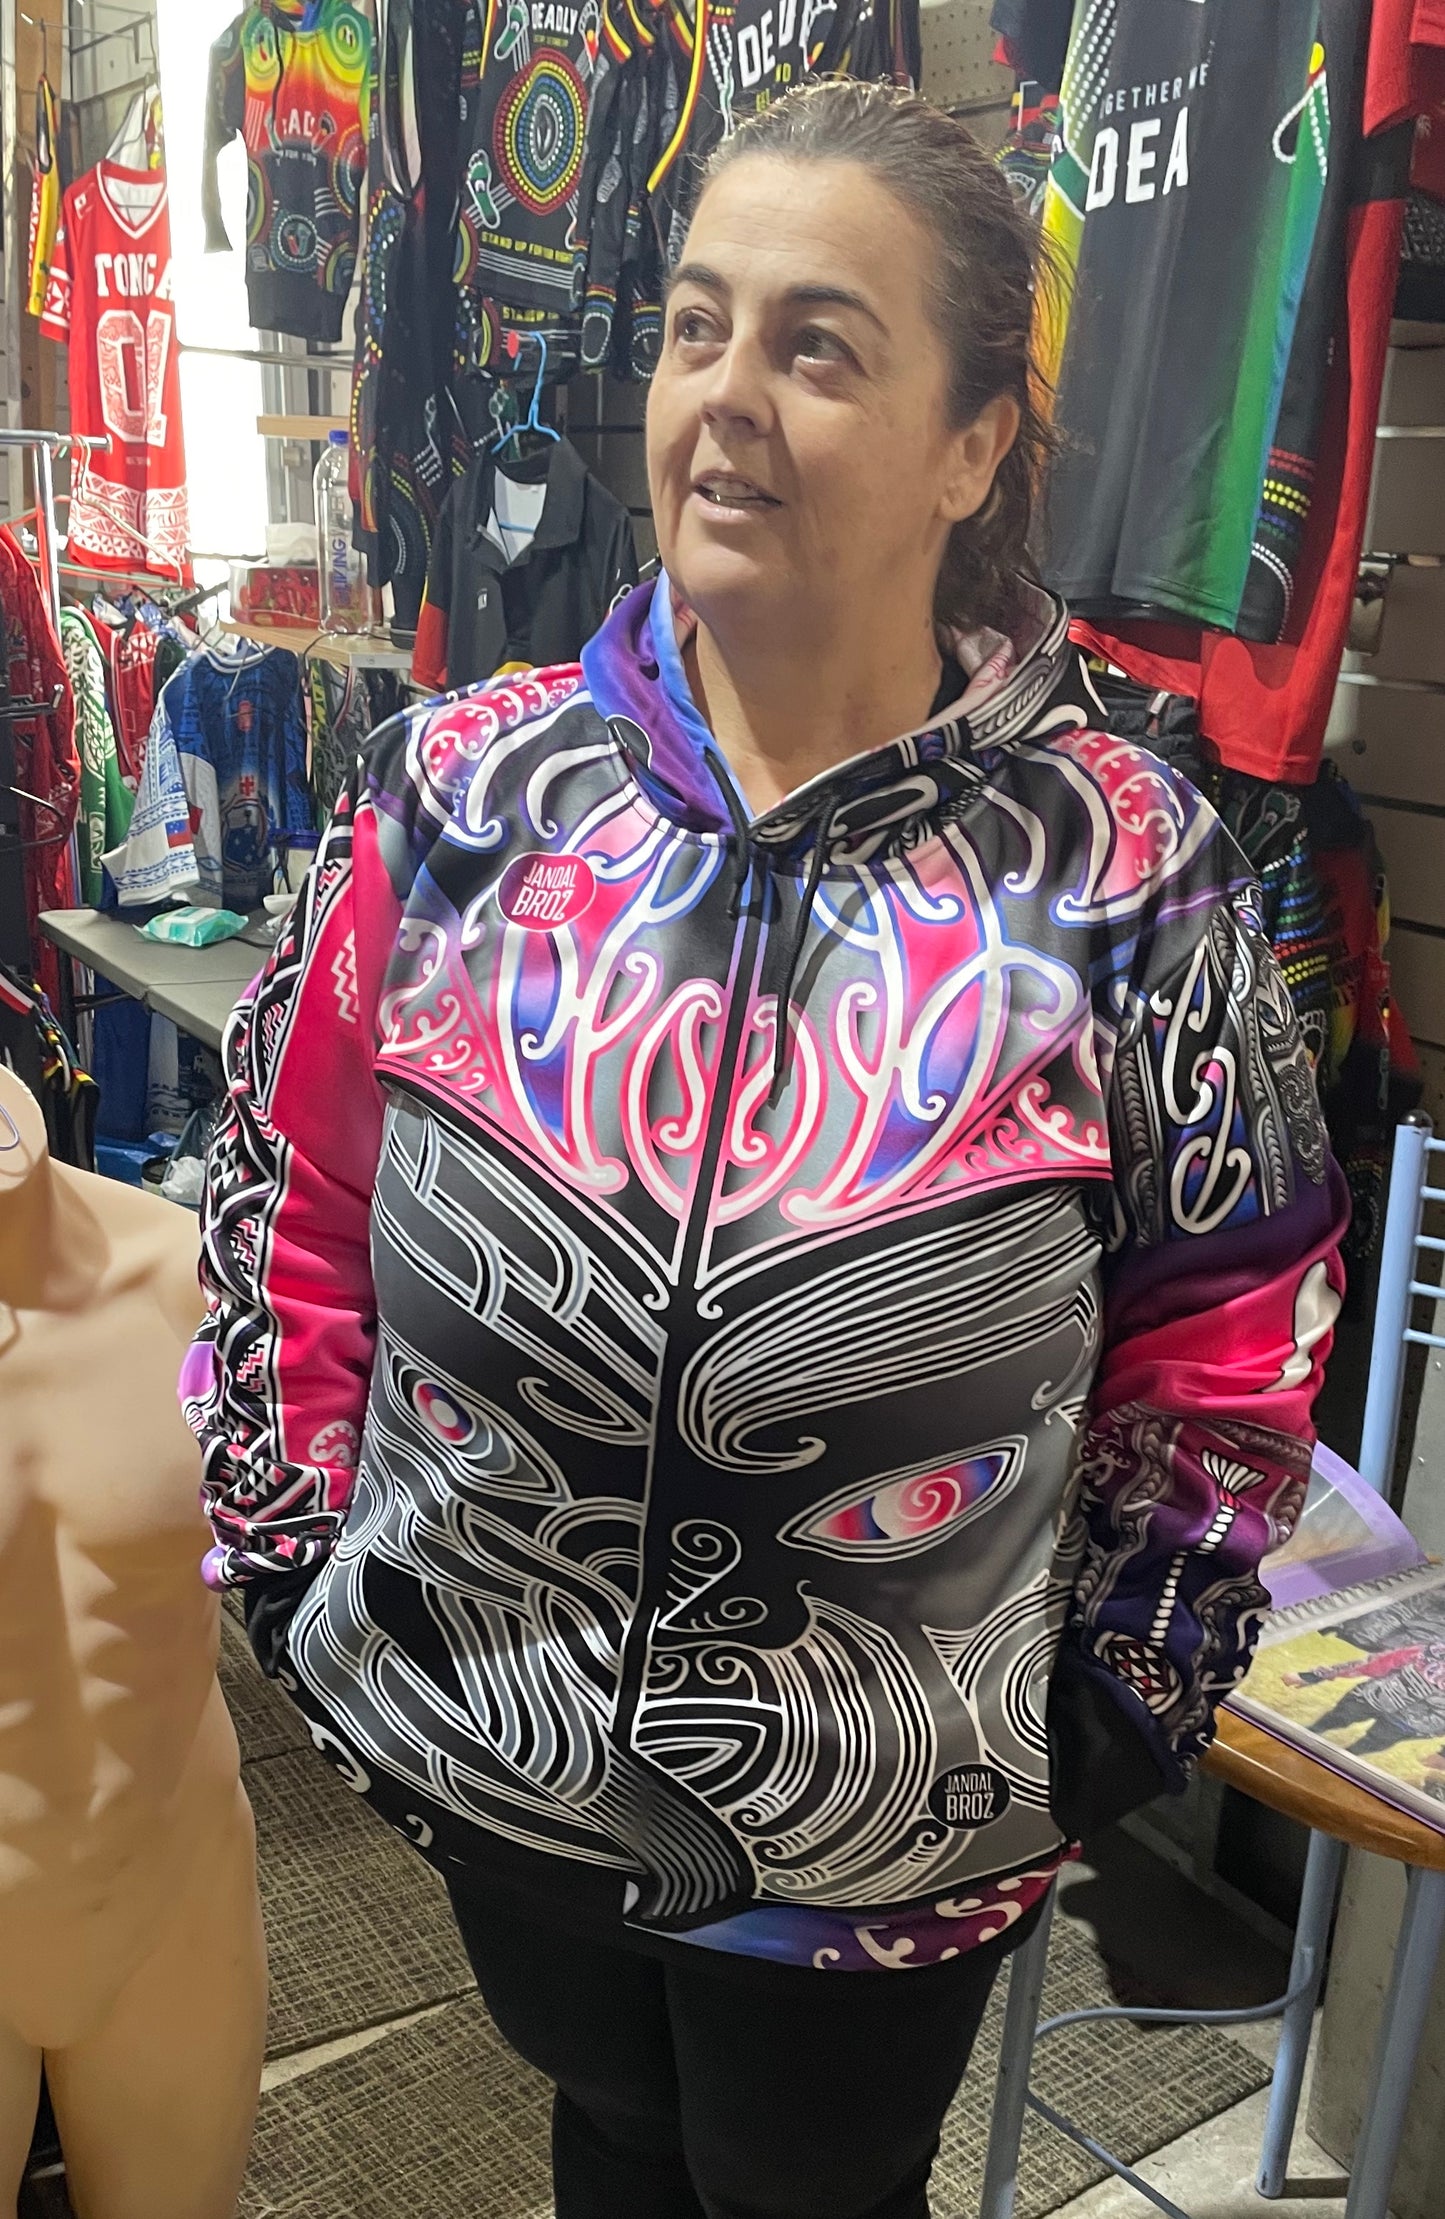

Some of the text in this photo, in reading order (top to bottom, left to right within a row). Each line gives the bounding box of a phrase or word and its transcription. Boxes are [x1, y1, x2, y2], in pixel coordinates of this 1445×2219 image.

[531, 2, 578, 35] DEADLY
[1085, 106, 1189, 212] DEA
[523, 861, 578, 889] JANDAL
[511, 885, 575, 922] BROZ
[944, 1772, 994, 1794] JANDAL
[946, 1792, 995, 1821] BROZ
